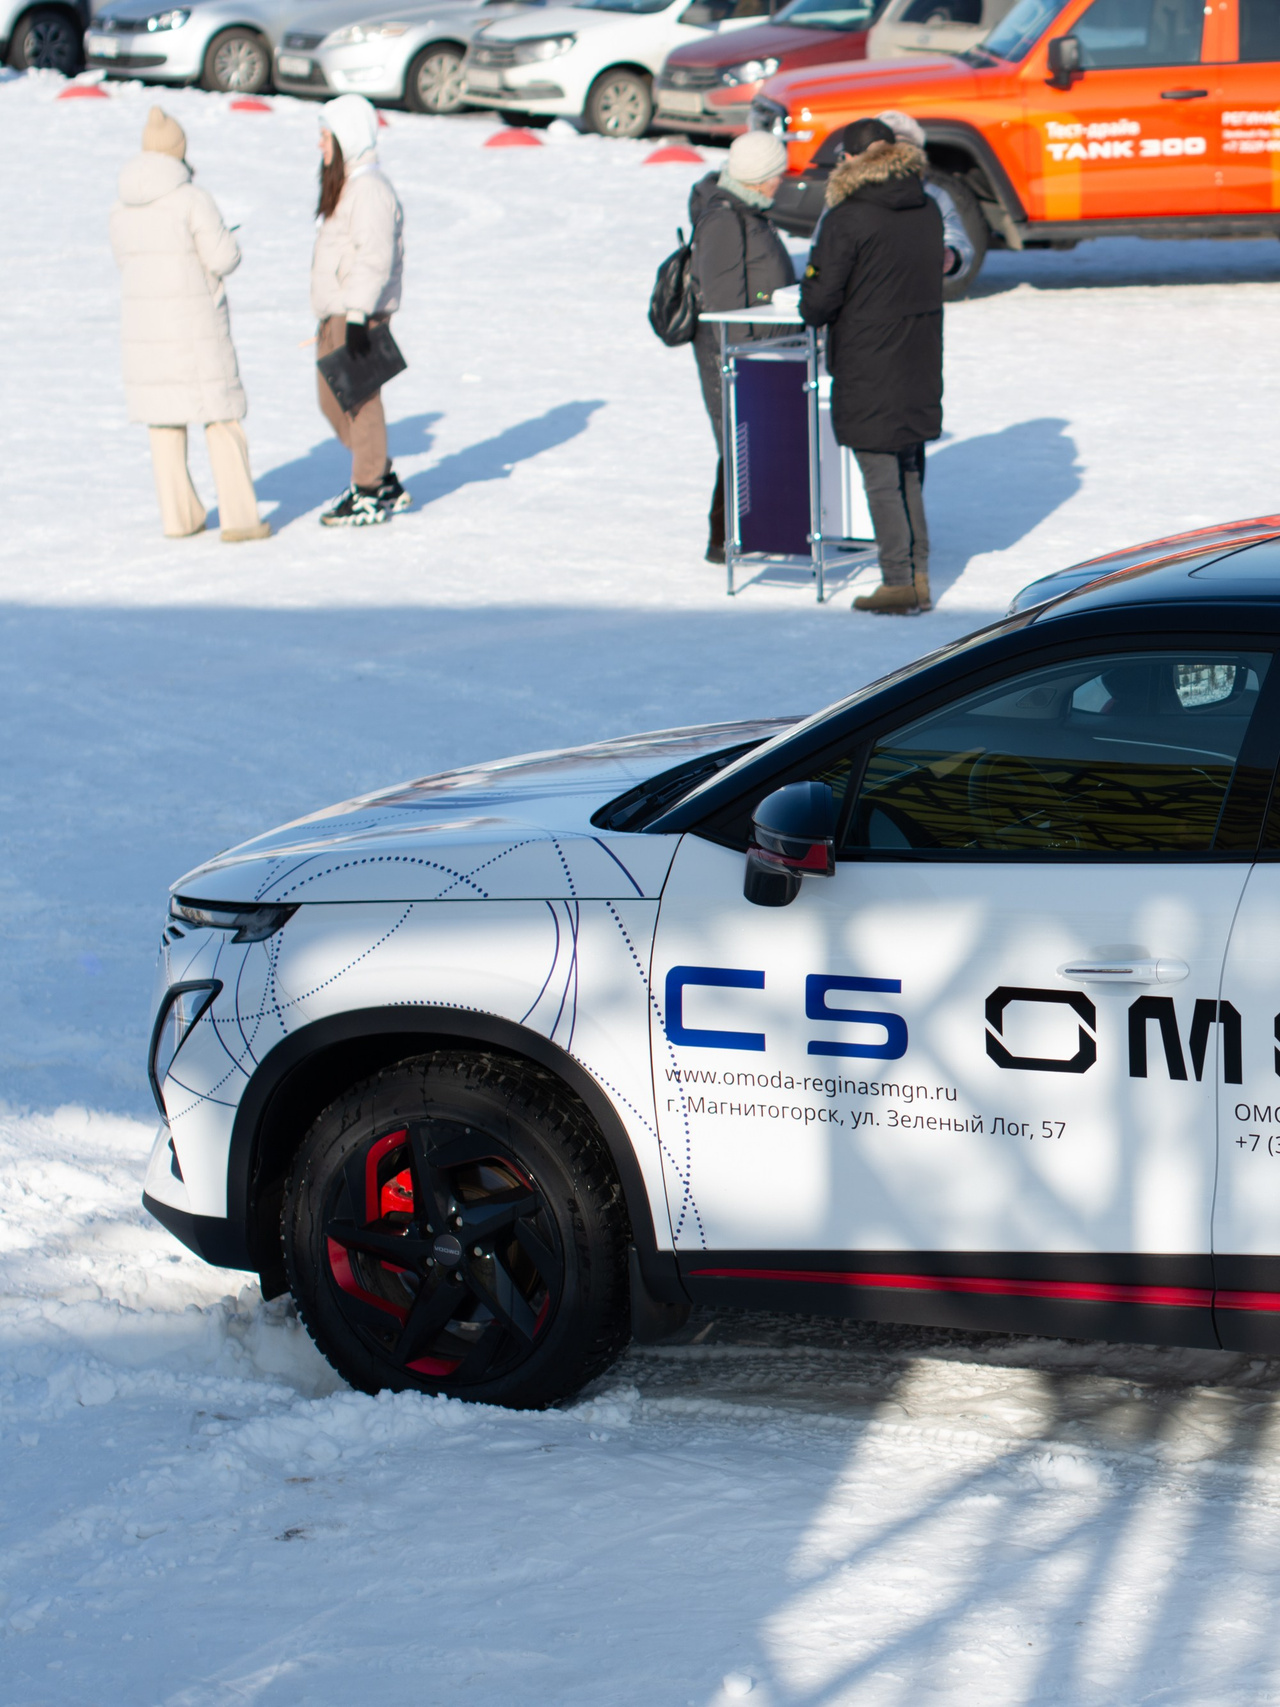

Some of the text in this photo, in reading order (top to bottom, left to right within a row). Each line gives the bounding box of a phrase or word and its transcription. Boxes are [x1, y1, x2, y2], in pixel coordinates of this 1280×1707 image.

[1046, 137, 1206, 161] TANK 300
[664, 1066, 958, 1103] www.omoda-reginasmgn.ru
[687, 1096, 844, 1127] Магнитогорск,
[850, 1110, 880, 1130] ул.
[886, 1109, 984, 1134] Зеленый
[990, 1116, 1034, 1141] Лог,
[1041, 1121, 1066, 1140] 57
[1235, 1133, 1261, 1152] +7
